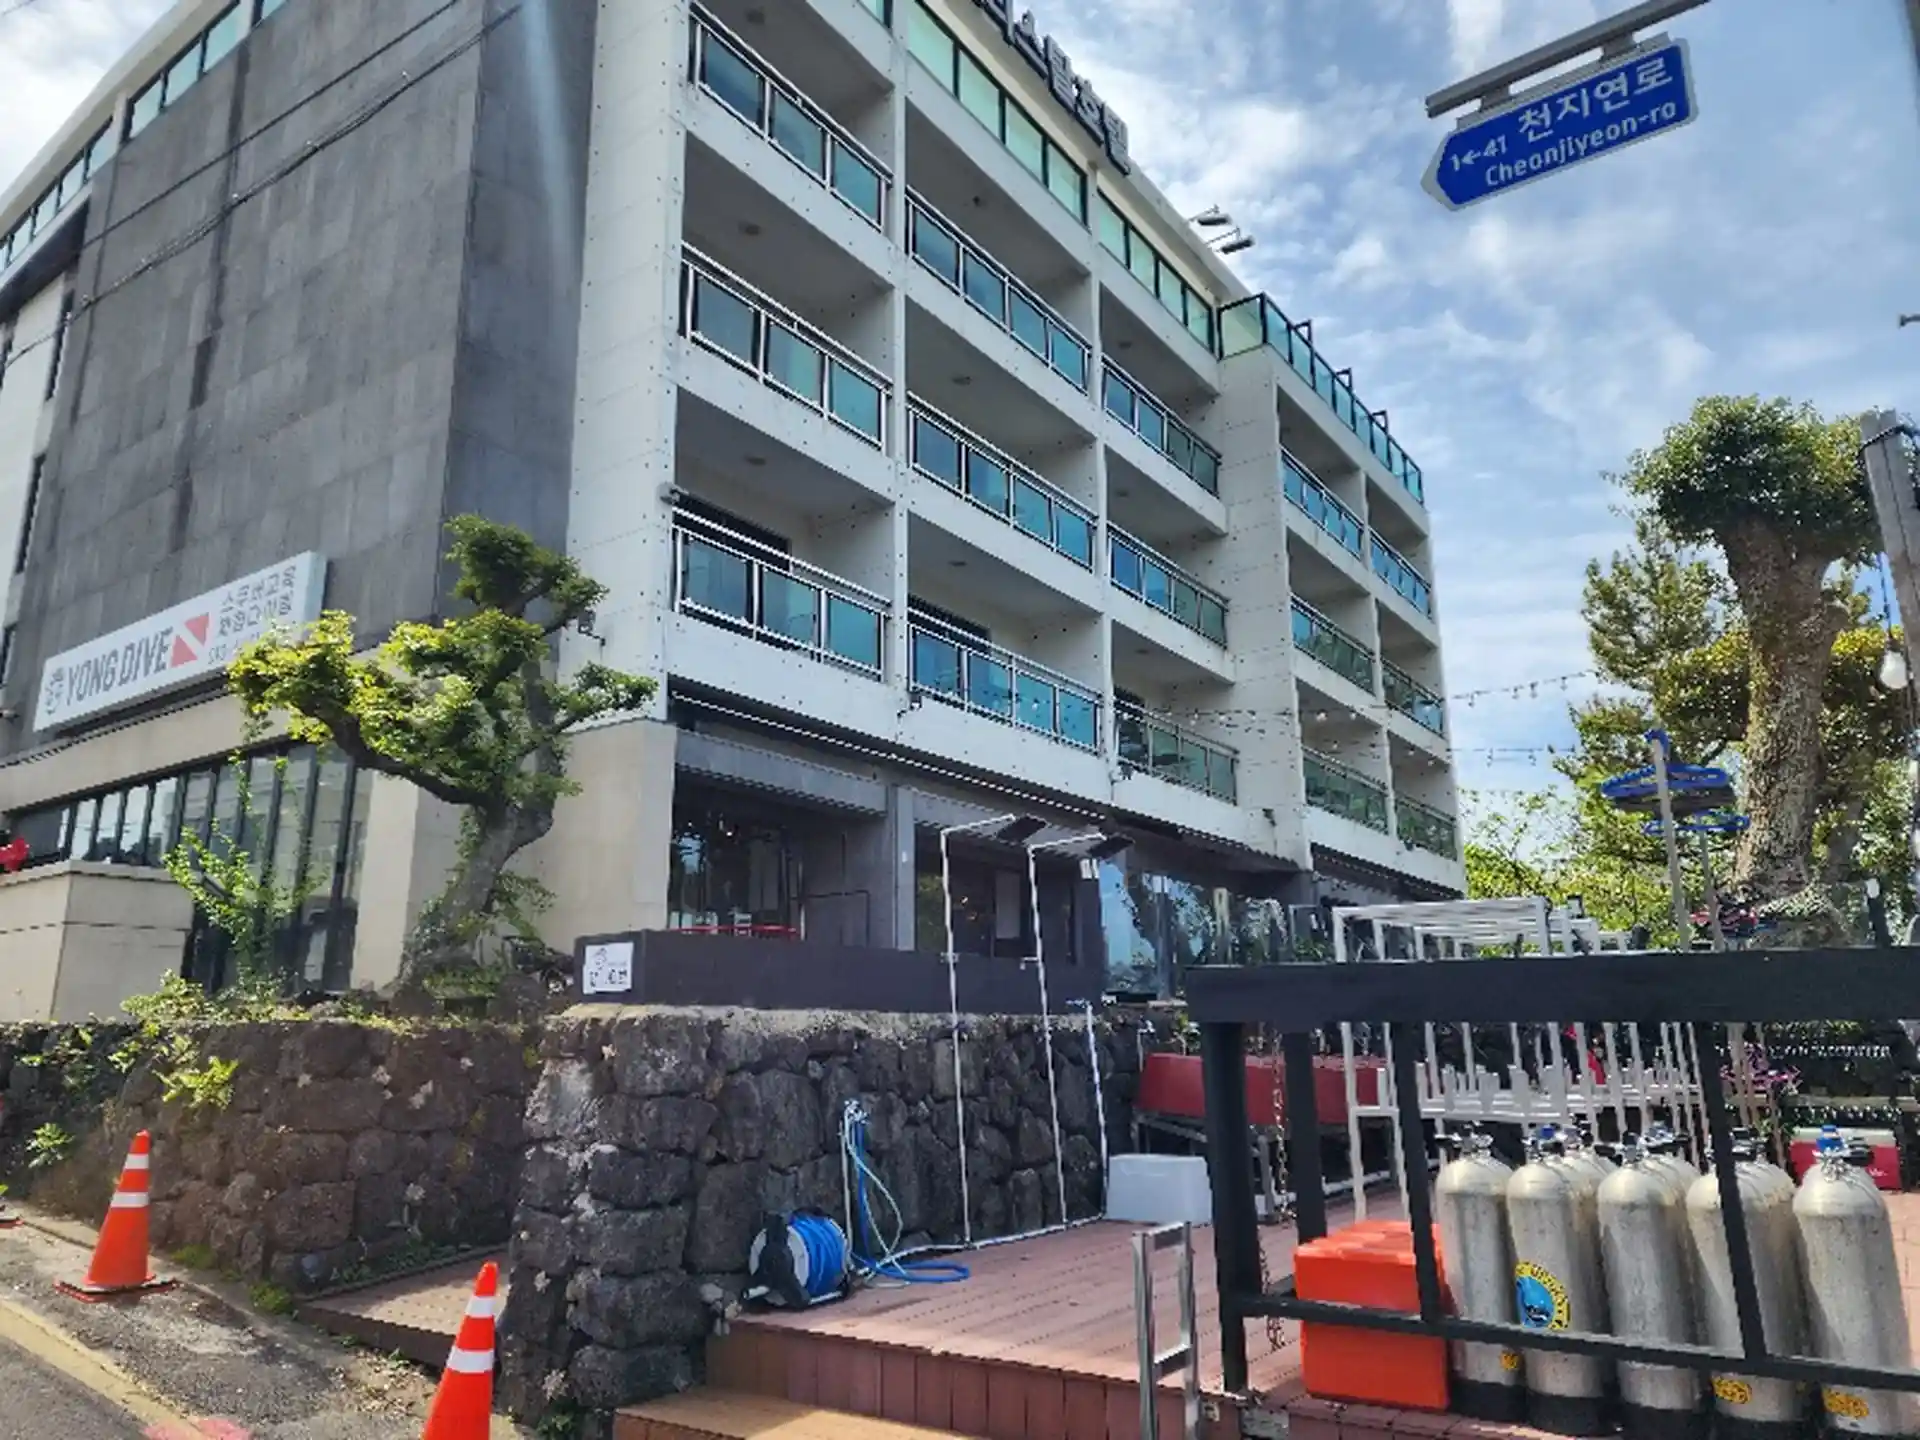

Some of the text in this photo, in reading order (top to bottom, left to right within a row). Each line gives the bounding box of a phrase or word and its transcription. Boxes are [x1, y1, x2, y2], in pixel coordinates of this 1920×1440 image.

[1518, 57, 1673, 143] 천지연로
[1485, 102, 1676, 186] Cheonjiyeon-ro
[66, 648, 119, 706] YONG
[118, 625, 173, 687] DIVE
